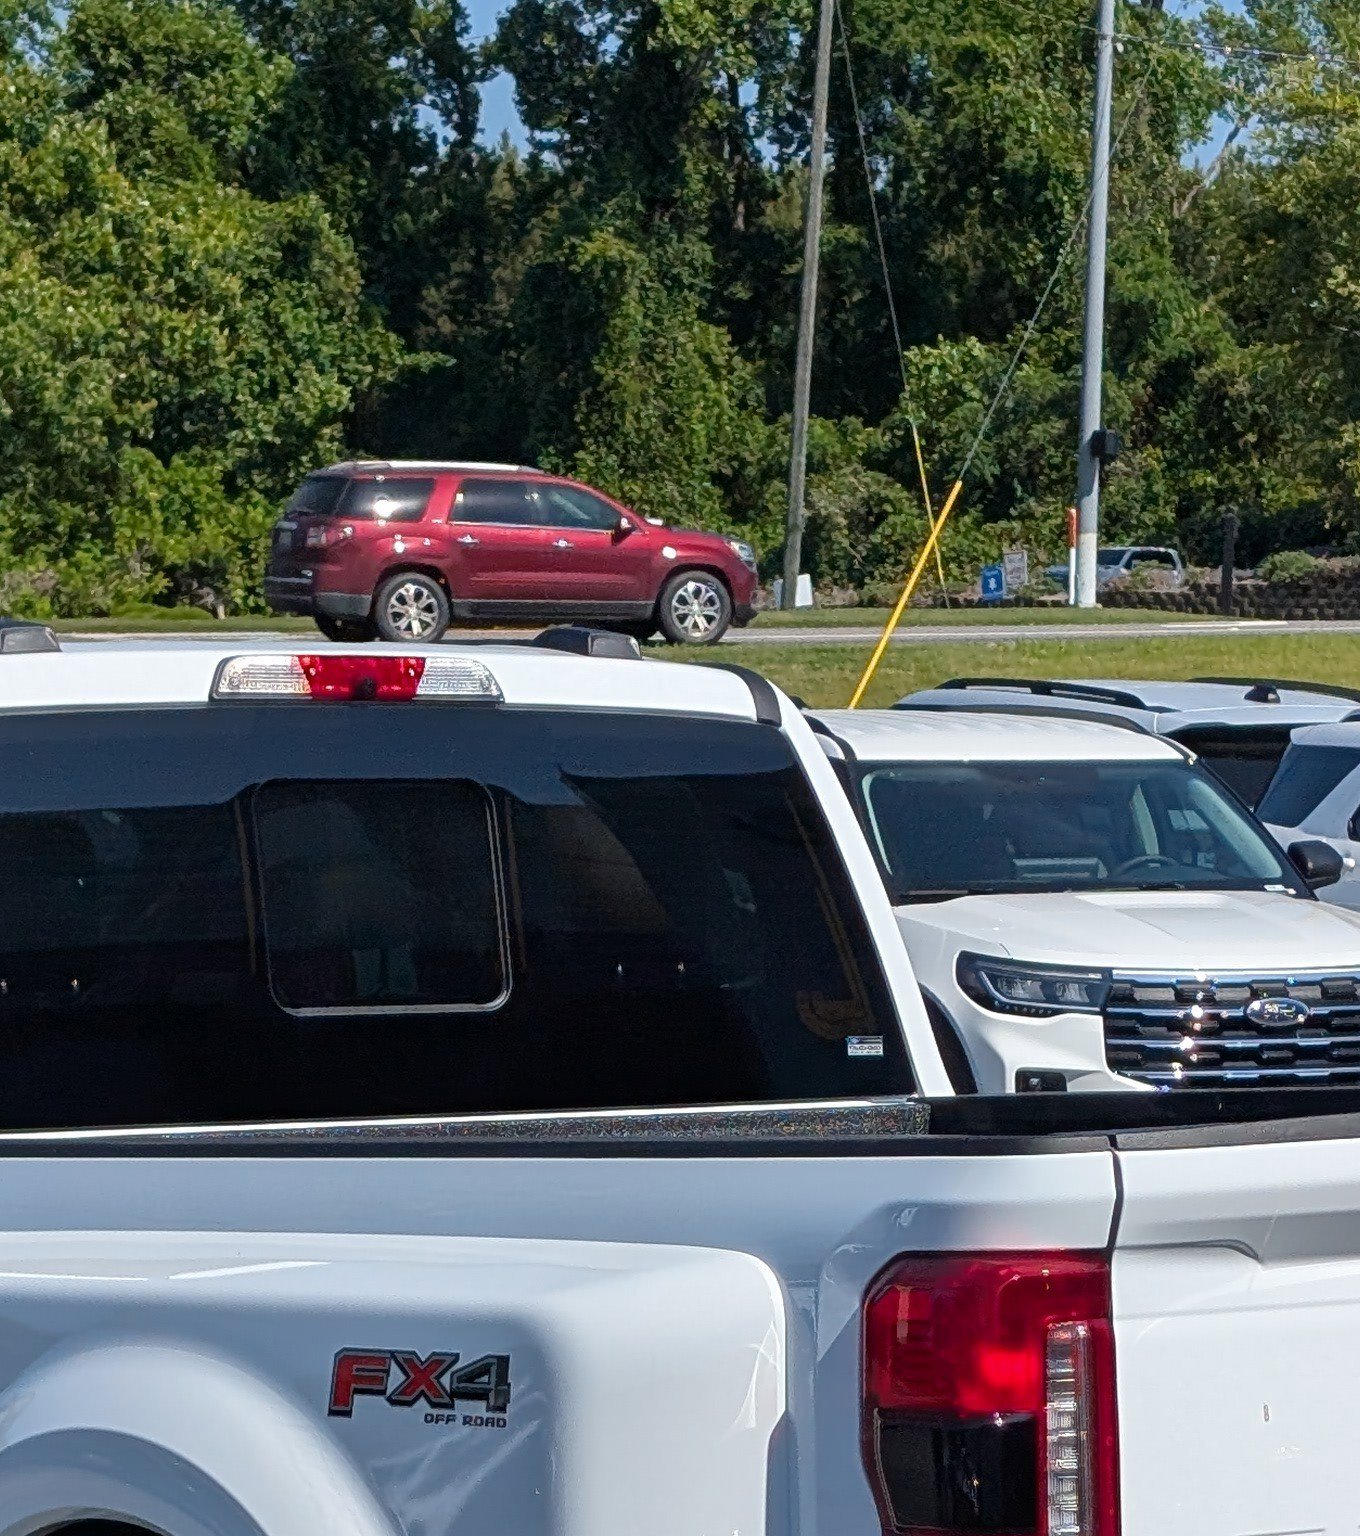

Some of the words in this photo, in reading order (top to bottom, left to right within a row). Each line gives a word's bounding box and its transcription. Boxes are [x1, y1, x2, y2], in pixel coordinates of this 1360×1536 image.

[328, 1346, 512, 1419] FX4
[423, 1412, 457, 1426] OFF
[461, 1415, 508, 1429] ROAD
